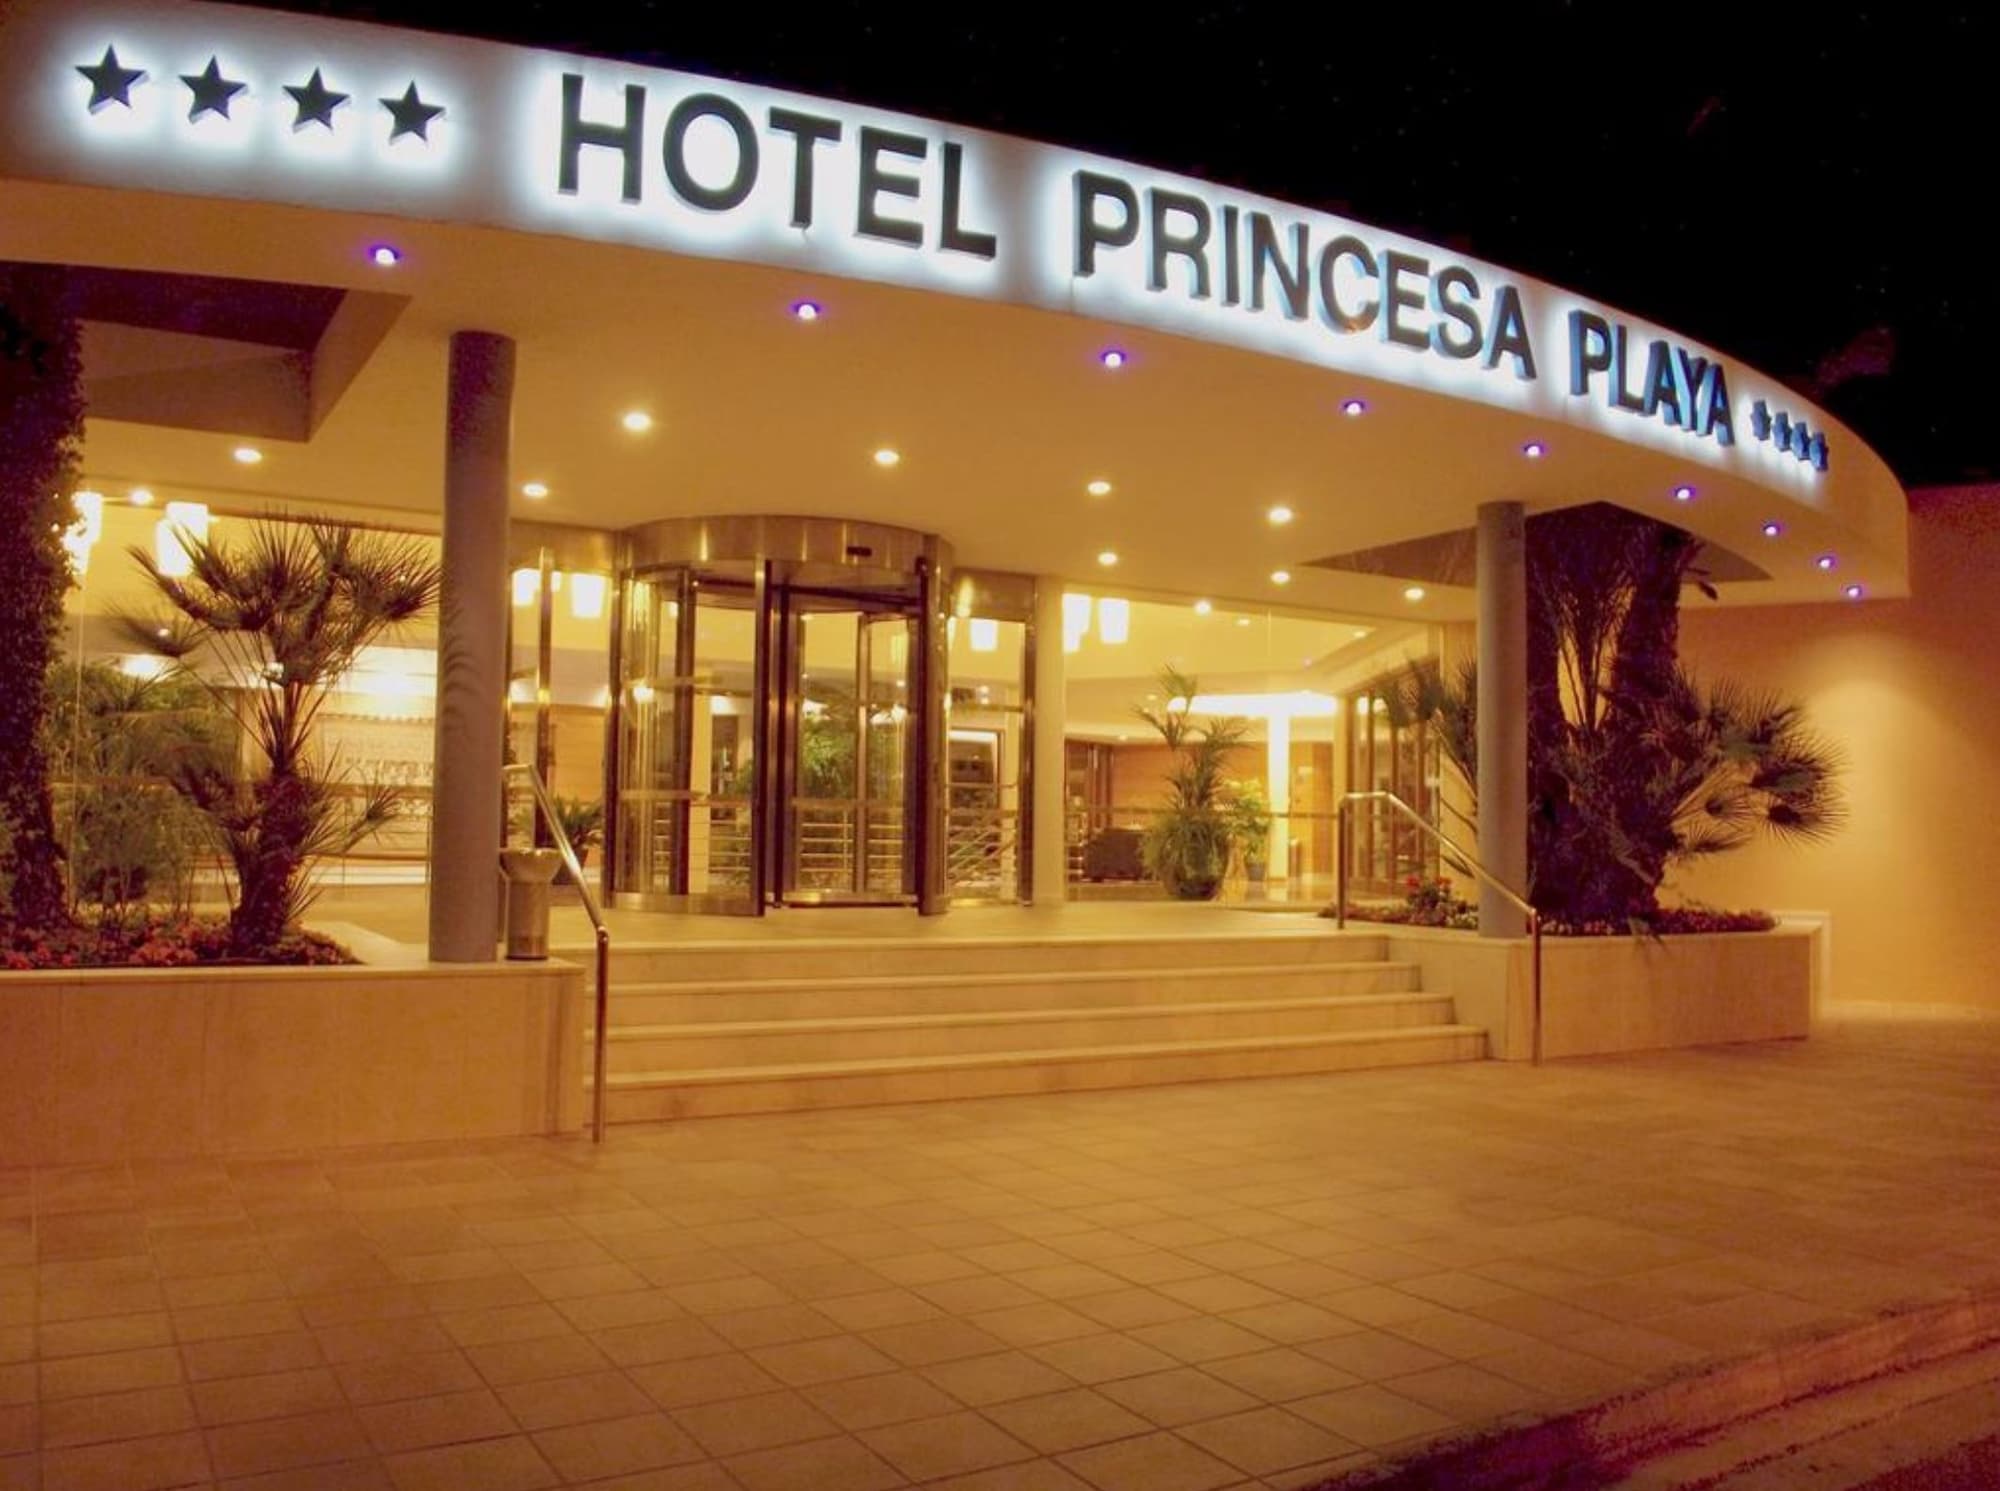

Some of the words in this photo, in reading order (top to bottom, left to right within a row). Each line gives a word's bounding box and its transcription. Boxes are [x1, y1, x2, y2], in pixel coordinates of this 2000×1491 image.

[558, 72, 996, 260] HOTEL
[1072, 169, 1537, 381] PRINCESA
[1568, 309, 1735, 447] PLAYA
